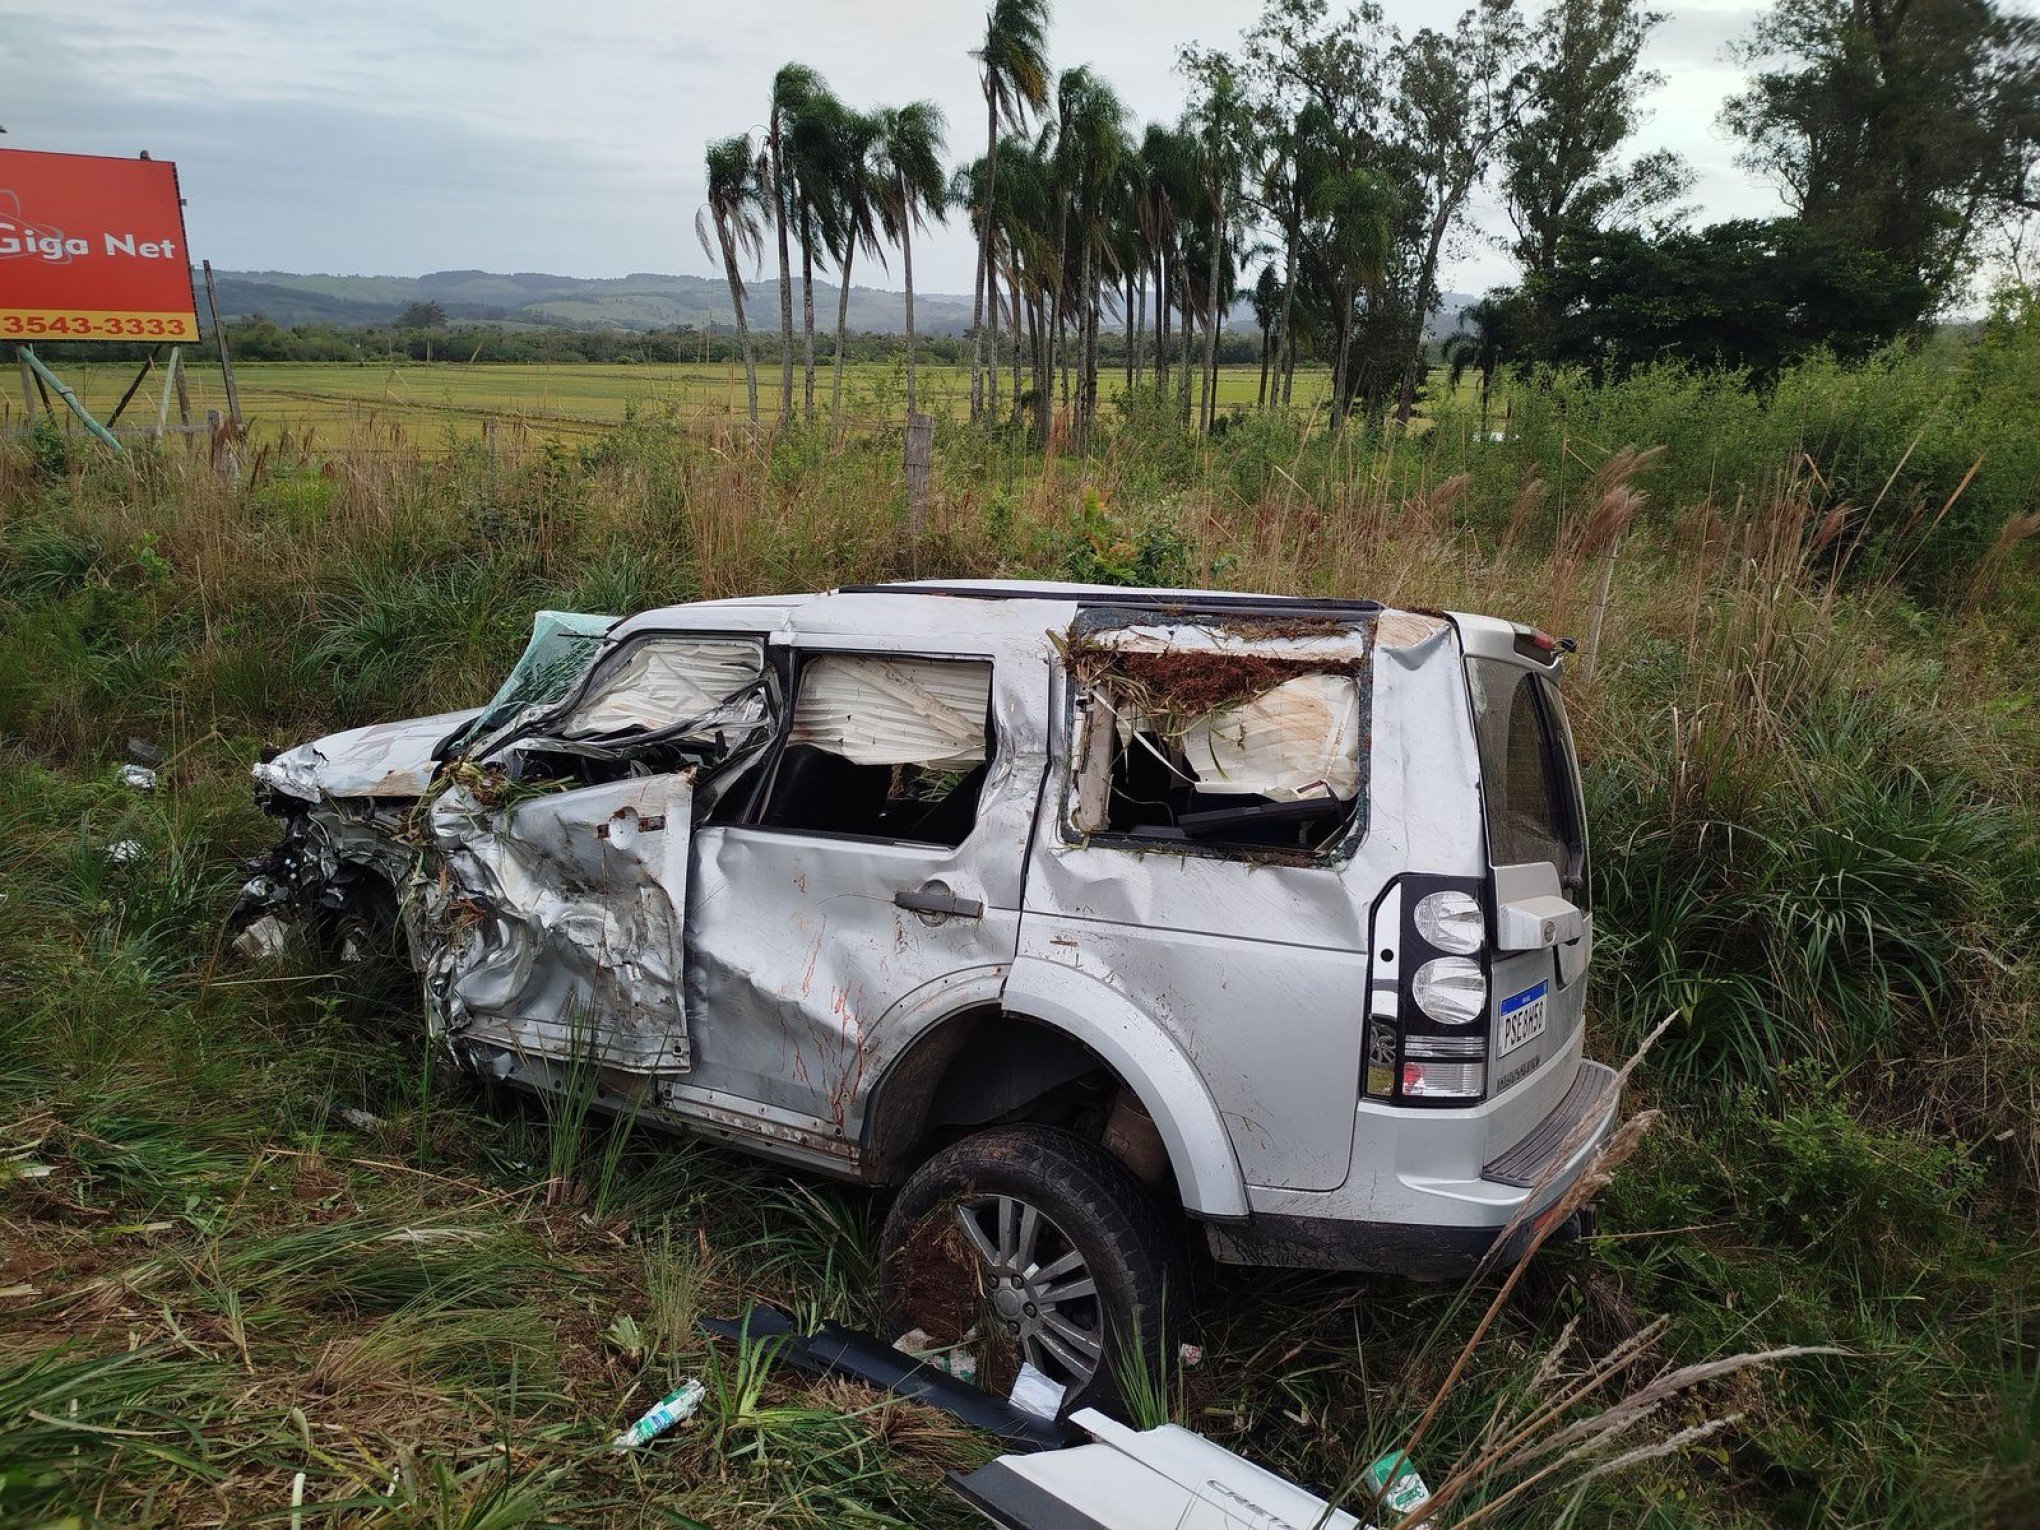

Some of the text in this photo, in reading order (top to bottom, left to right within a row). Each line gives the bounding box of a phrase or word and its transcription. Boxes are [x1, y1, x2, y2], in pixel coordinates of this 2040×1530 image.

[0, 222, 176, 260] Giga Net
[2, 315, 187, 336] 3543-3333
